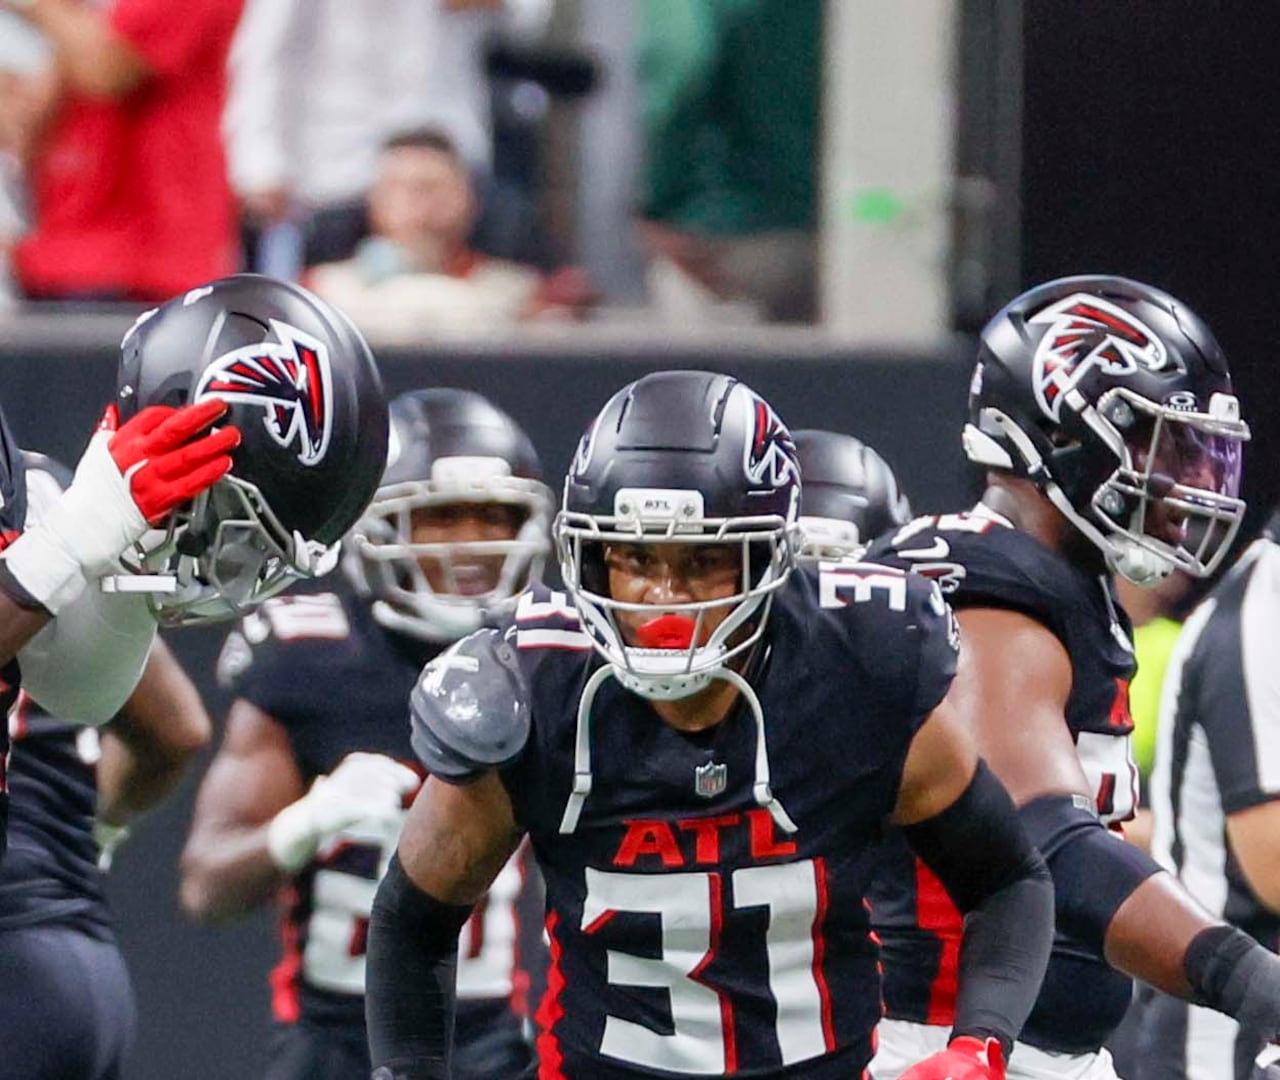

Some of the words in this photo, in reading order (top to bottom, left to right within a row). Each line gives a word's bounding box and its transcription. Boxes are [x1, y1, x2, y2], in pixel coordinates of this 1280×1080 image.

[644, 500, 671, 510] ATL
[612, 809, 798, 867] ATL
[581, 857, 836, 1075] 31
